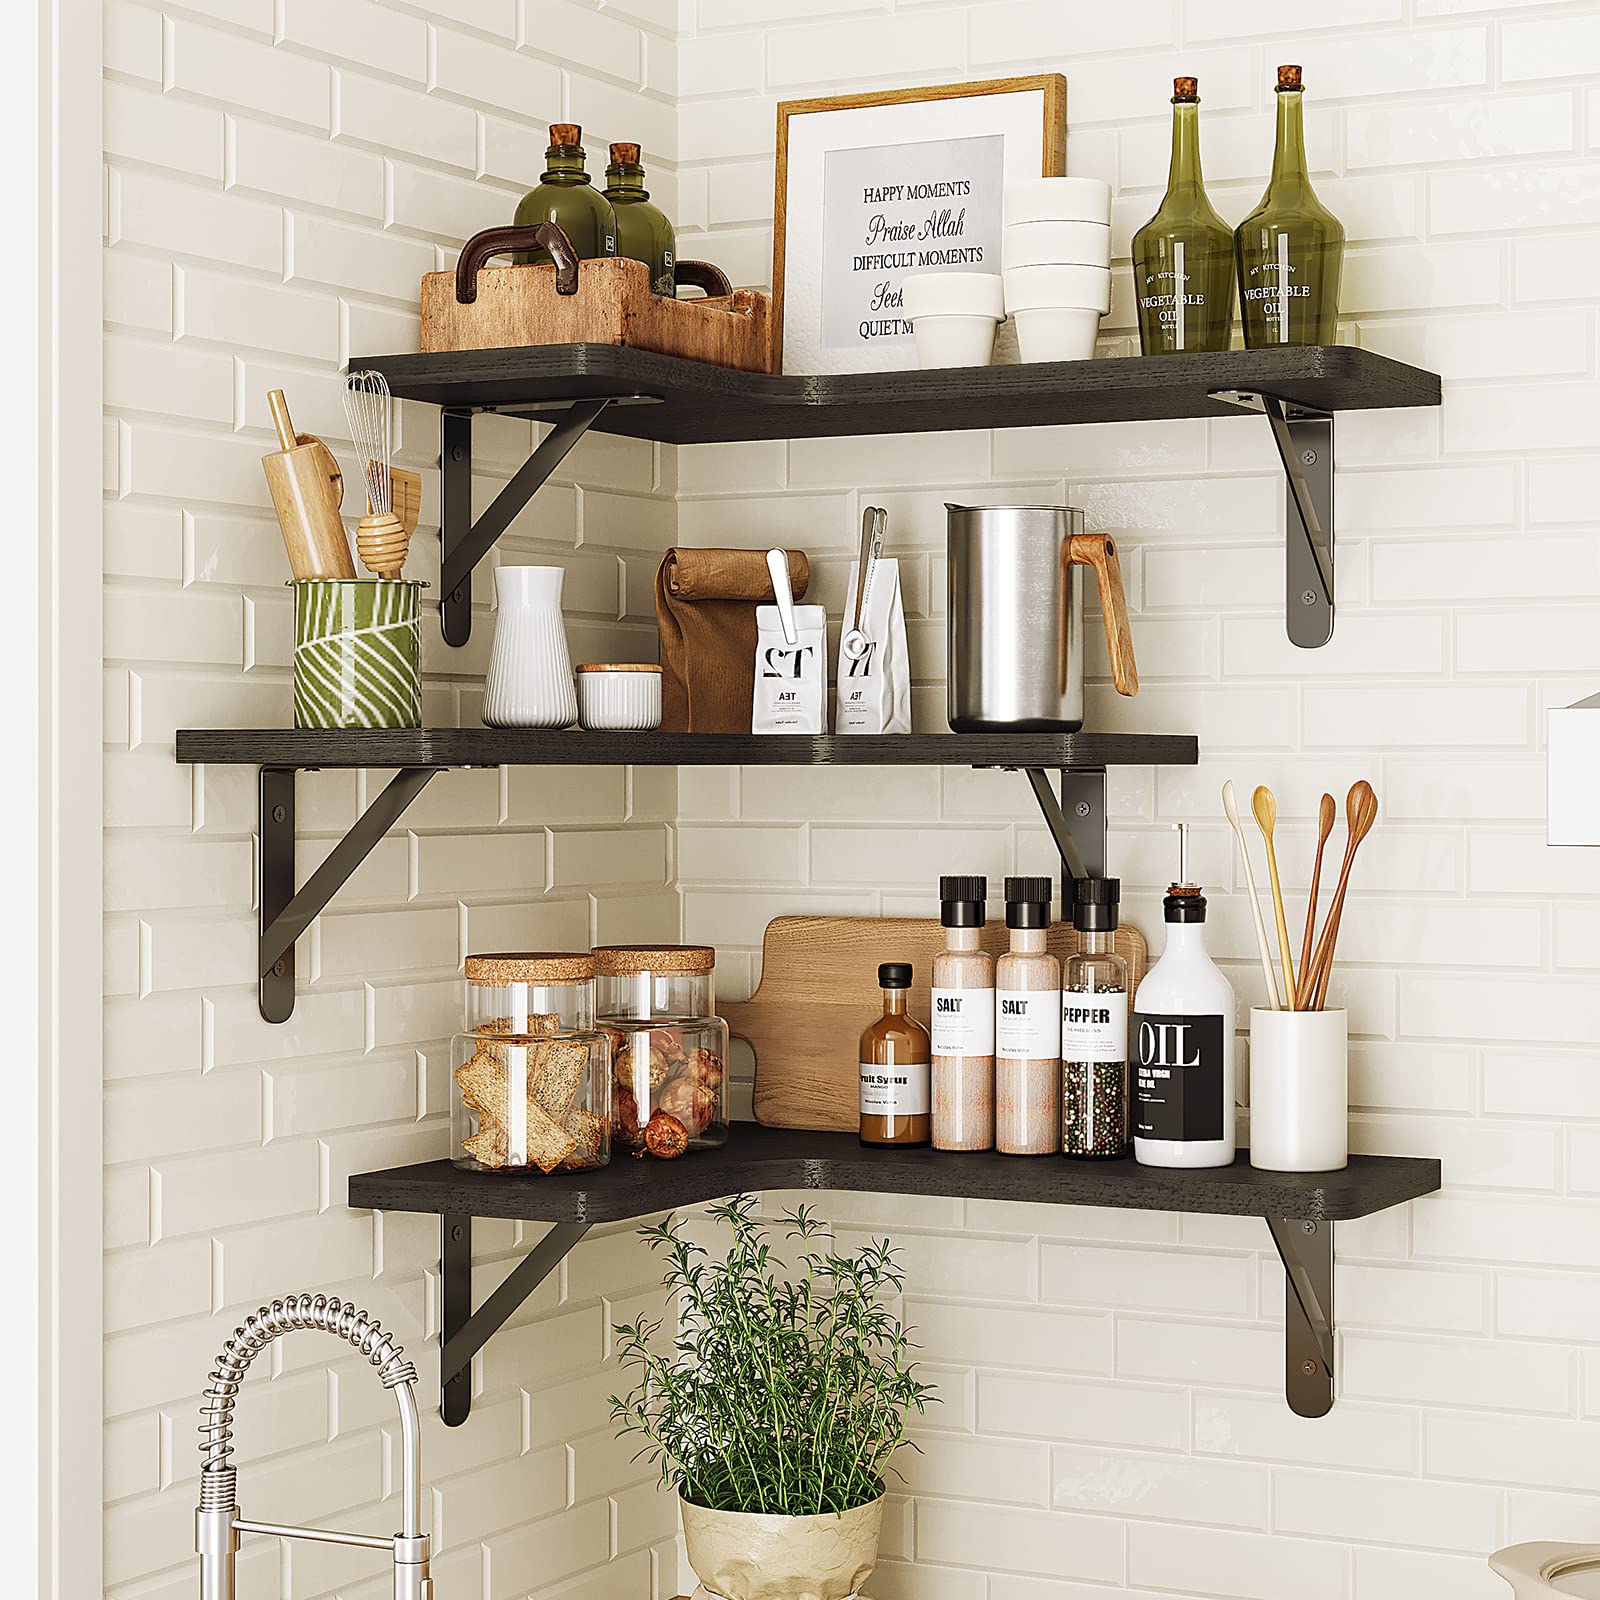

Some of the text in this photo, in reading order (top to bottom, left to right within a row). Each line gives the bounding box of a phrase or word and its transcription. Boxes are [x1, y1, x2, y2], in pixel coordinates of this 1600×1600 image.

[864, 180, 970, 203] HAPPY MOMENTS
[865, 208, 966, 246] Praise Allah
[853, 247, 983, 271] DIFFICULT MOMENTS
[1140, 293, 1206, 309] VEGETABLE
[1244, 285, 1311, 301] VEGETABLE
[1159, 310, 1180, 322] OIL
[1263, 302, 1286, 314] OIL
[859, 320, 900, 339] QUIET
[937, 997, 963, 1012] SALT
[1002, 999, 1028, 1014] SALT
[1063, 1007, 1110, 1024] PEPPER
[1139, 1021, 1200, 1067] OIL
[859, 1073, 875, 1084] ruit
